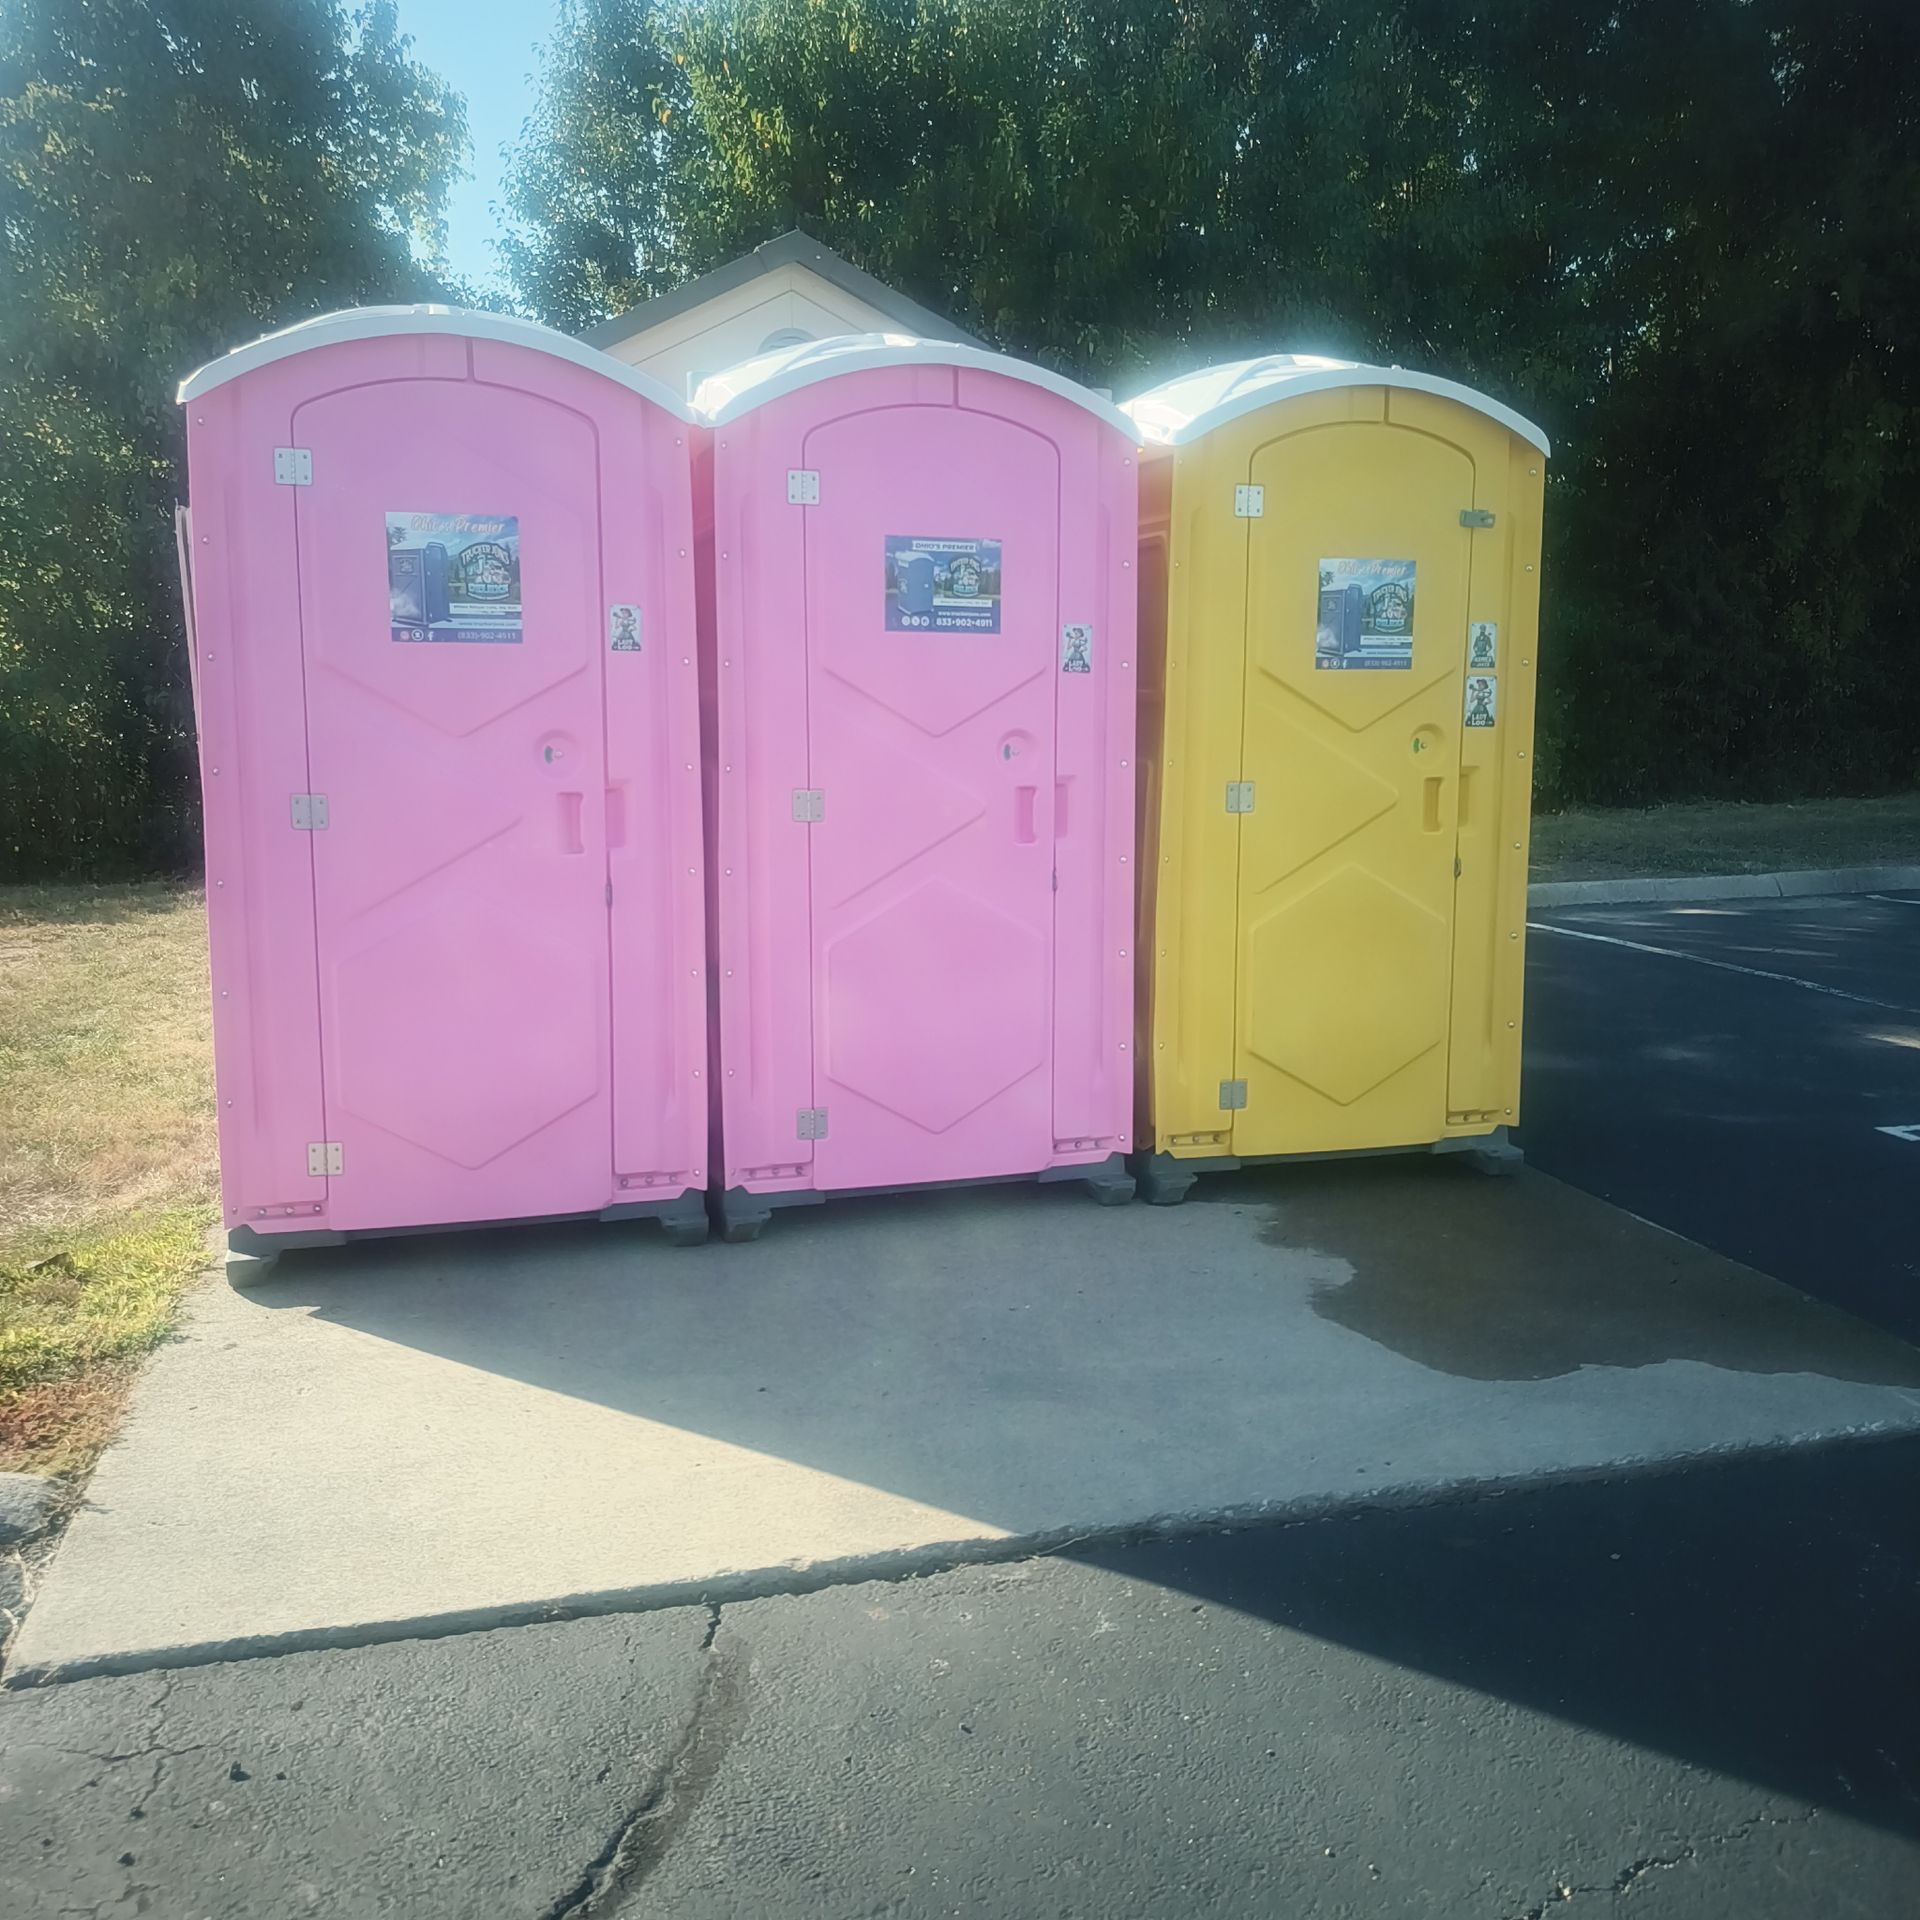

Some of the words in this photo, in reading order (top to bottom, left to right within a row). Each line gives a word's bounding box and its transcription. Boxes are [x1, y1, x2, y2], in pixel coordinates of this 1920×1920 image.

[455, 517, 505, 534] Premier
[914, 542, 941, 550] OHIO'S
[942, 543, 975, 551] PREMIER
